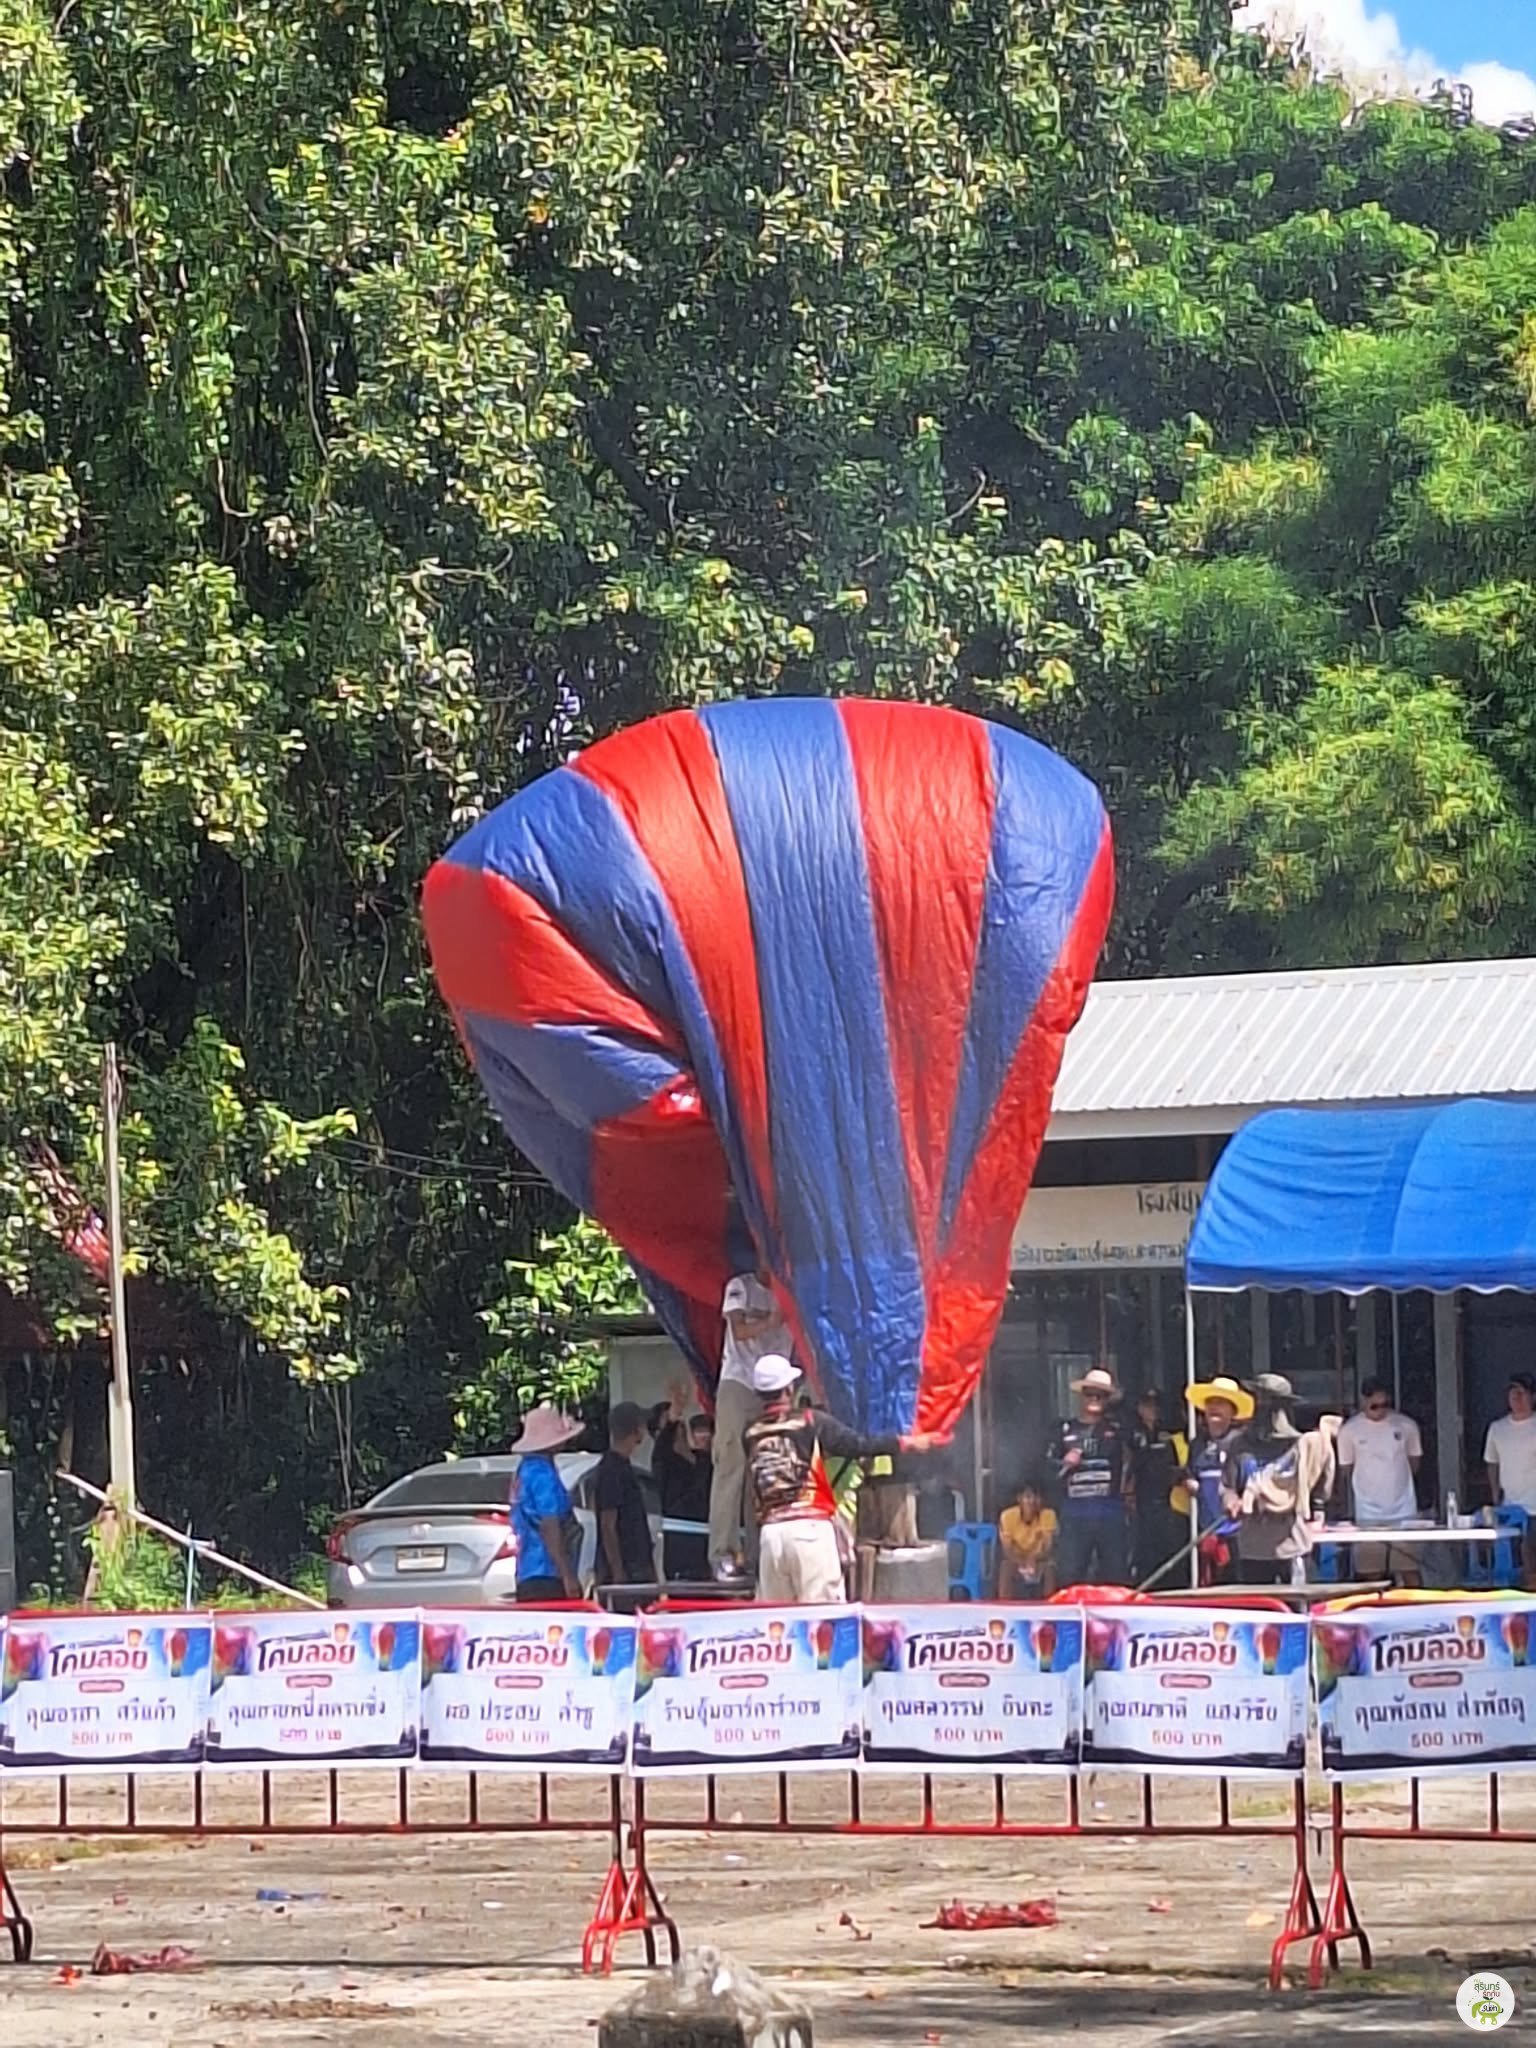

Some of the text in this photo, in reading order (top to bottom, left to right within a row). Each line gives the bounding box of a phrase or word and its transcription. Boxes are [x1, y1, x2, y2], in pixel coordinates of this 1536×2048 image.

[49, 1643, 148, 1677] โคมลอย
[257, 1638, 356, 1672] โคมลอย
[464, 1637, 569, 1670] โคมลอย
[687, 1638, 793, 1673] โคมลอย
[904, 1633, 1014, 1669] โคมลอย
[1128, 1633, 1237, 1669] โคมลอย
[1371, 1634, 1485, 1672] โคมลอย
